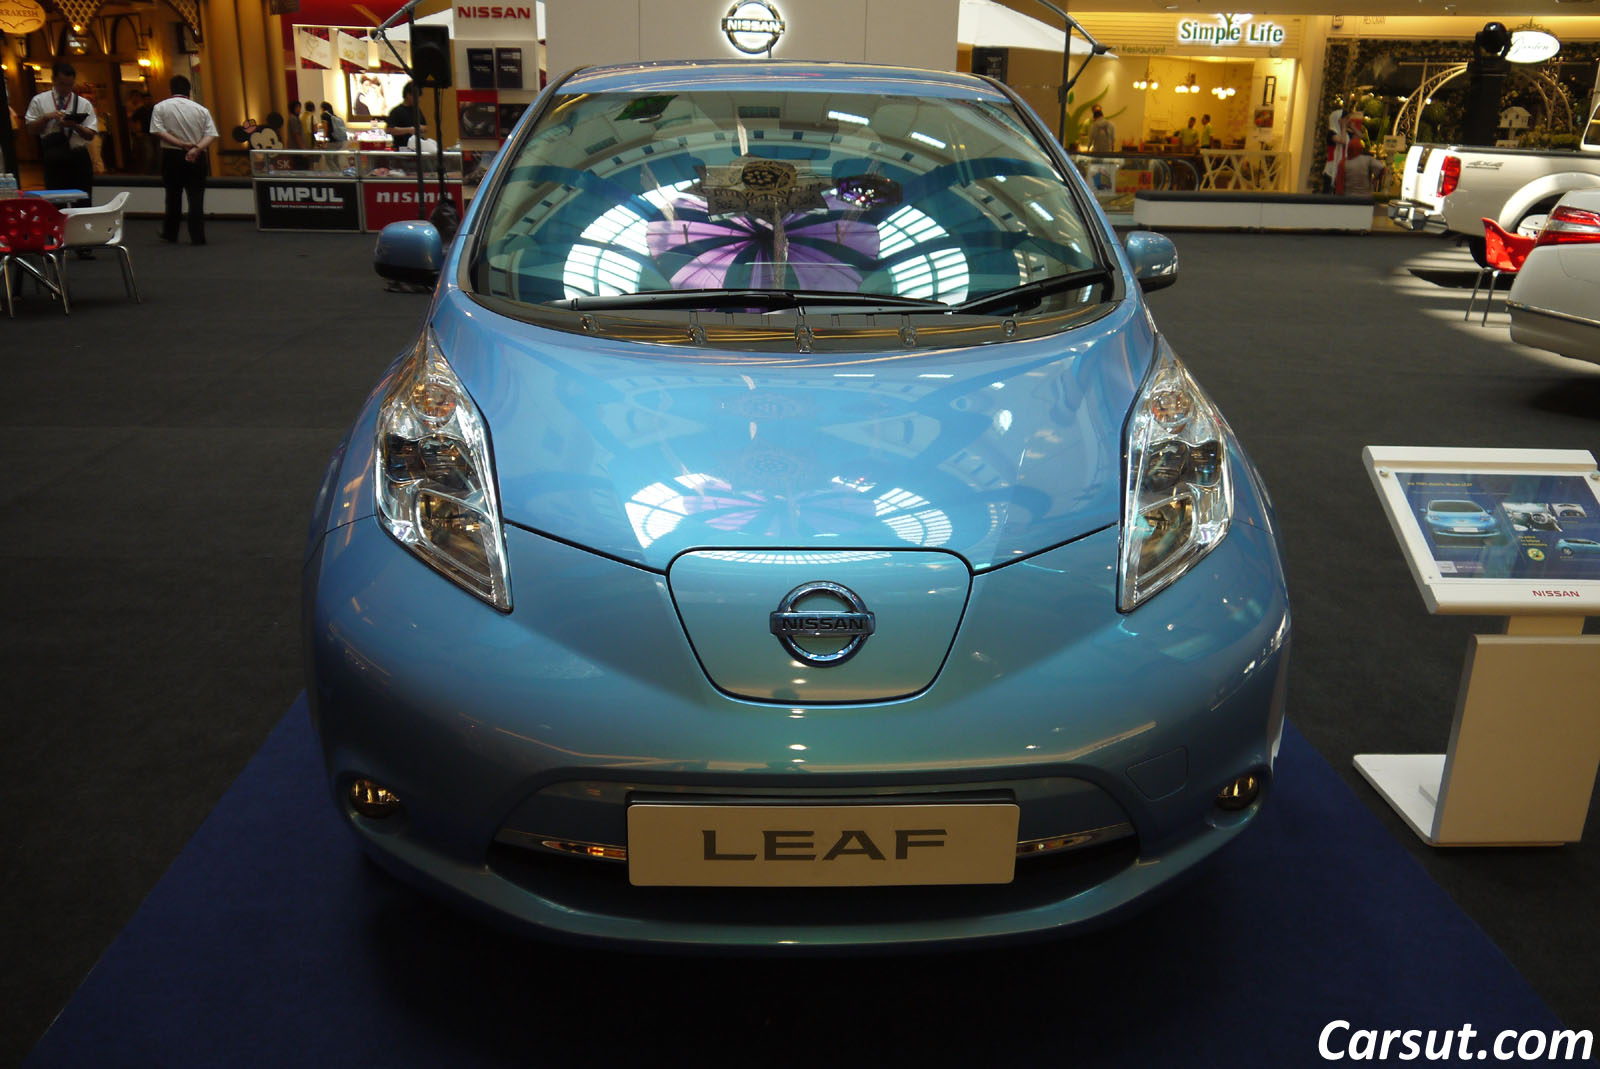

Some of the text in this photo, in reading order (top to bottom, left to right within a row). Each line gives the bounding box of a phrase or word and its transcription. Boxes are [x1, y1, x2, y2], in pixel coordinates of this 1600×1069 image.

[457, 6, 531, 19] NISSAN
[727, 19, 780, 33] NISSAN
[1180, 19, 1284, 44] Simple Life
[269, 186, 344, 202] IMPUL
[1532, 590, 1580, 598] NISSAN
[781, 618, 864, 630] NISSAN
[702, 829, 948, 861] LEAF
